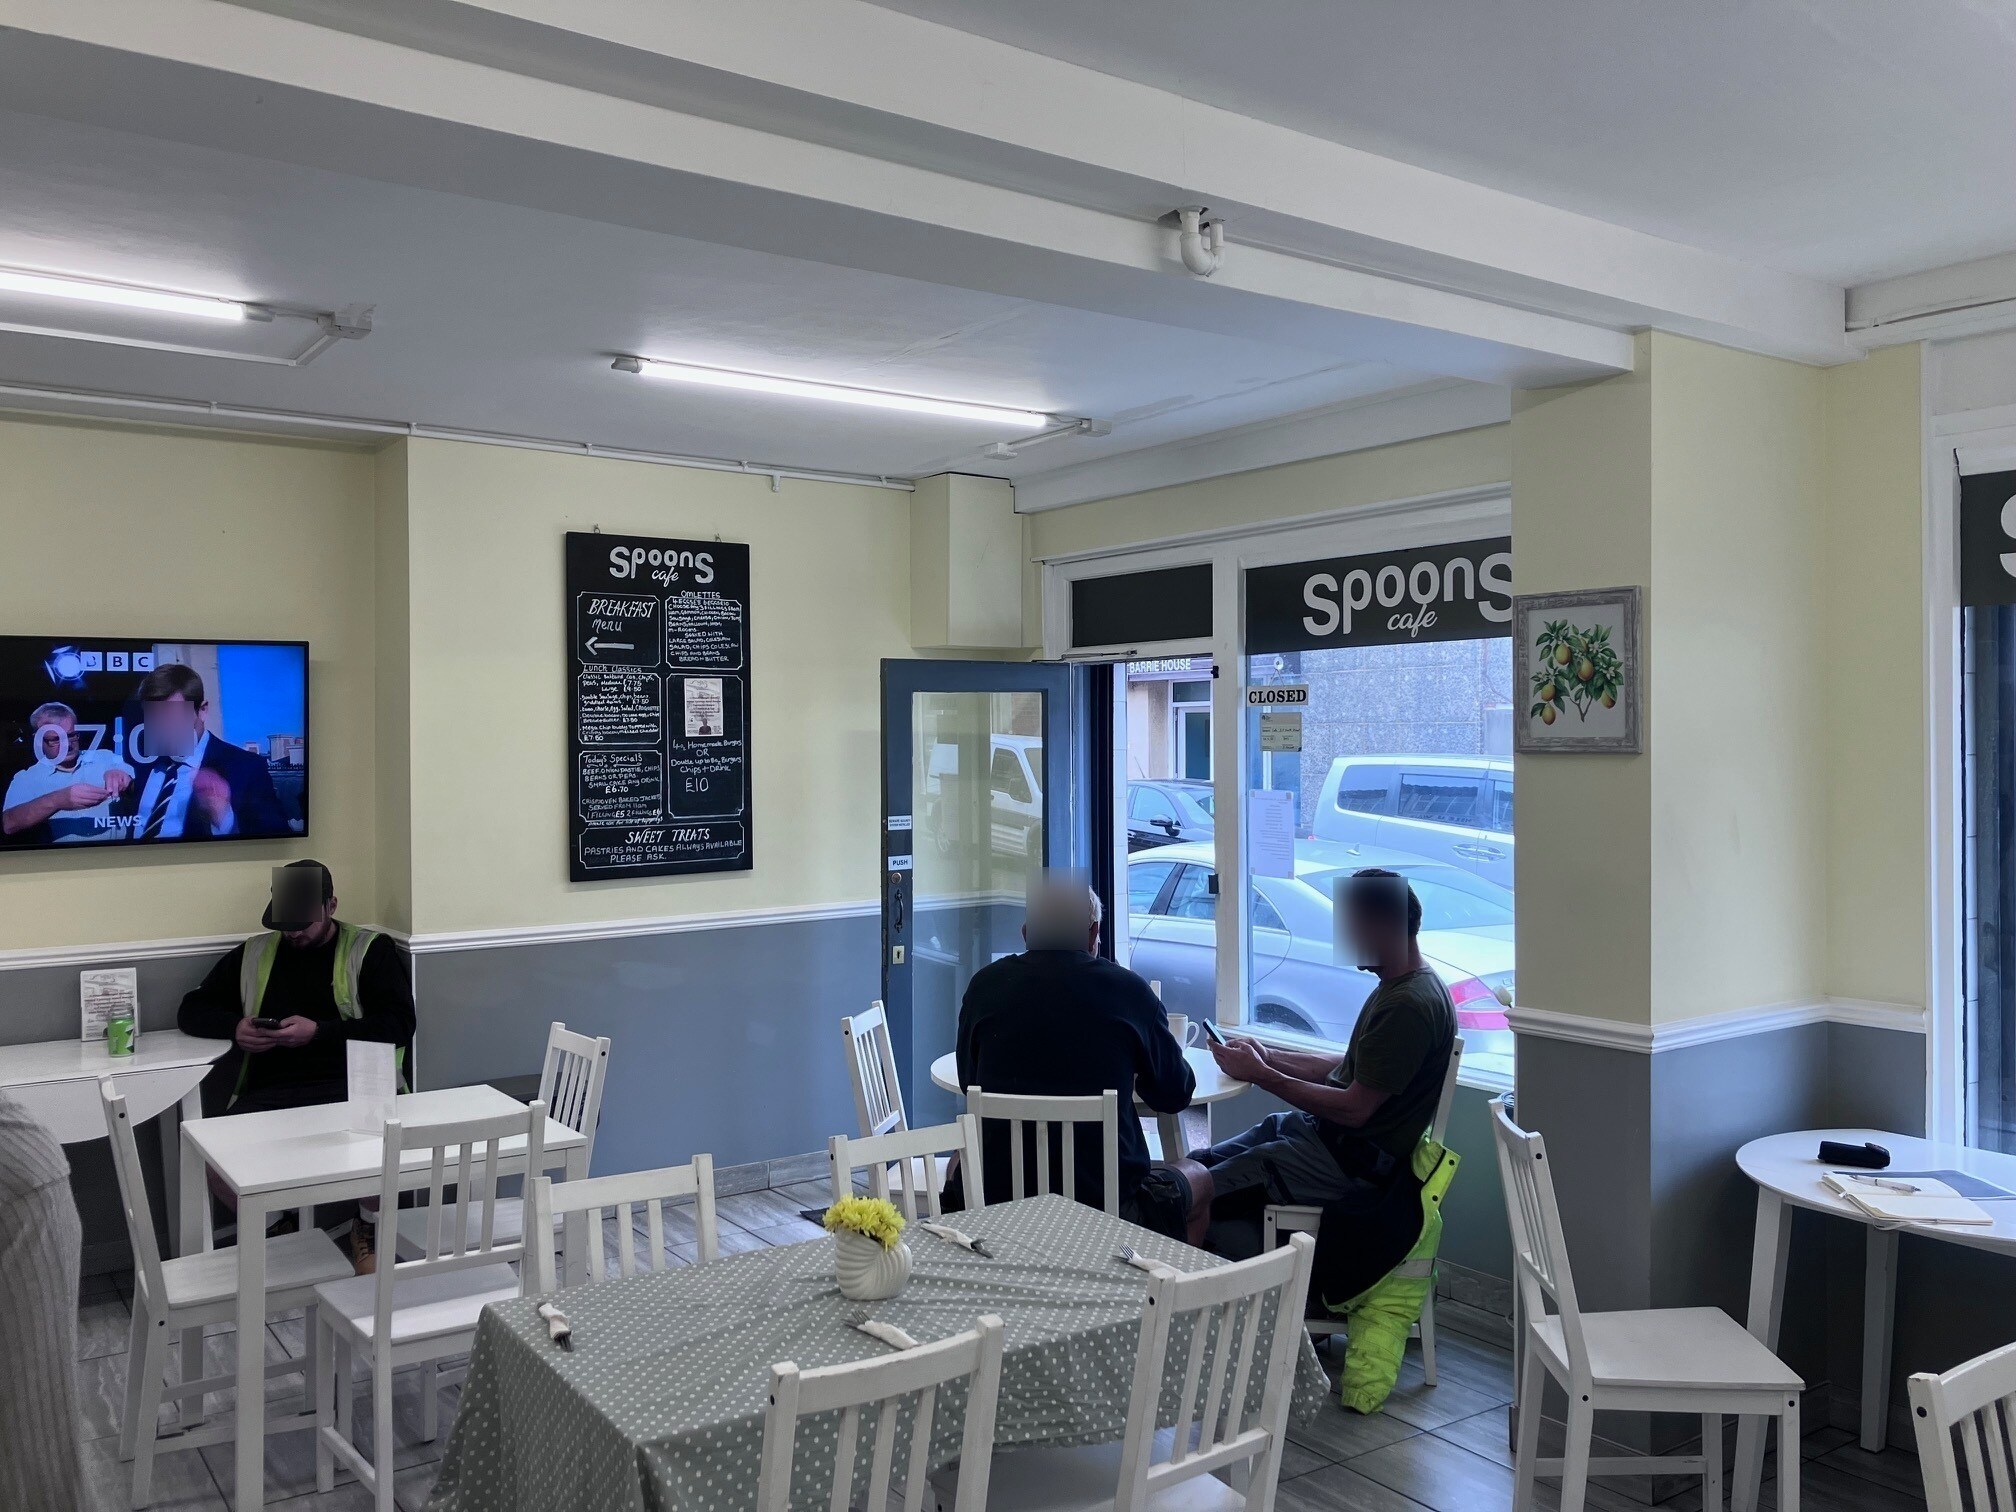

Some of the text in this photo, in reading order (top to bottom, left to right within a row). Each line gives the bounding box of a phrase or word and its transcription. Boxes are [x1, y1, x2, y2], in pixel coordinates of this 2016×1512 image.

[652, 566, 679, 587] cafe
[587, 599, 656, 618] BREAKFAST
[1387, 603, 1437, 638] cafe
[1130, 658, 1191, 673] BARRIE HOUSE
[1249, 689, 1307, 703] CLOSED
[680, 766, 701, 776] Chips
[606, 786, 628, 794] £6.70
[686, 777, 709, 792] £10
[94, 815, 145, 828] NEWS
[625, 828, 710, 844] SWEET TREATS
[584, 847, 624, 856] PASTRIES
[645, 845, 674, 853] CAKES
[706, 840, 742, 850] AVAILABLE
[610, 854, 642, 864] PLEASE
